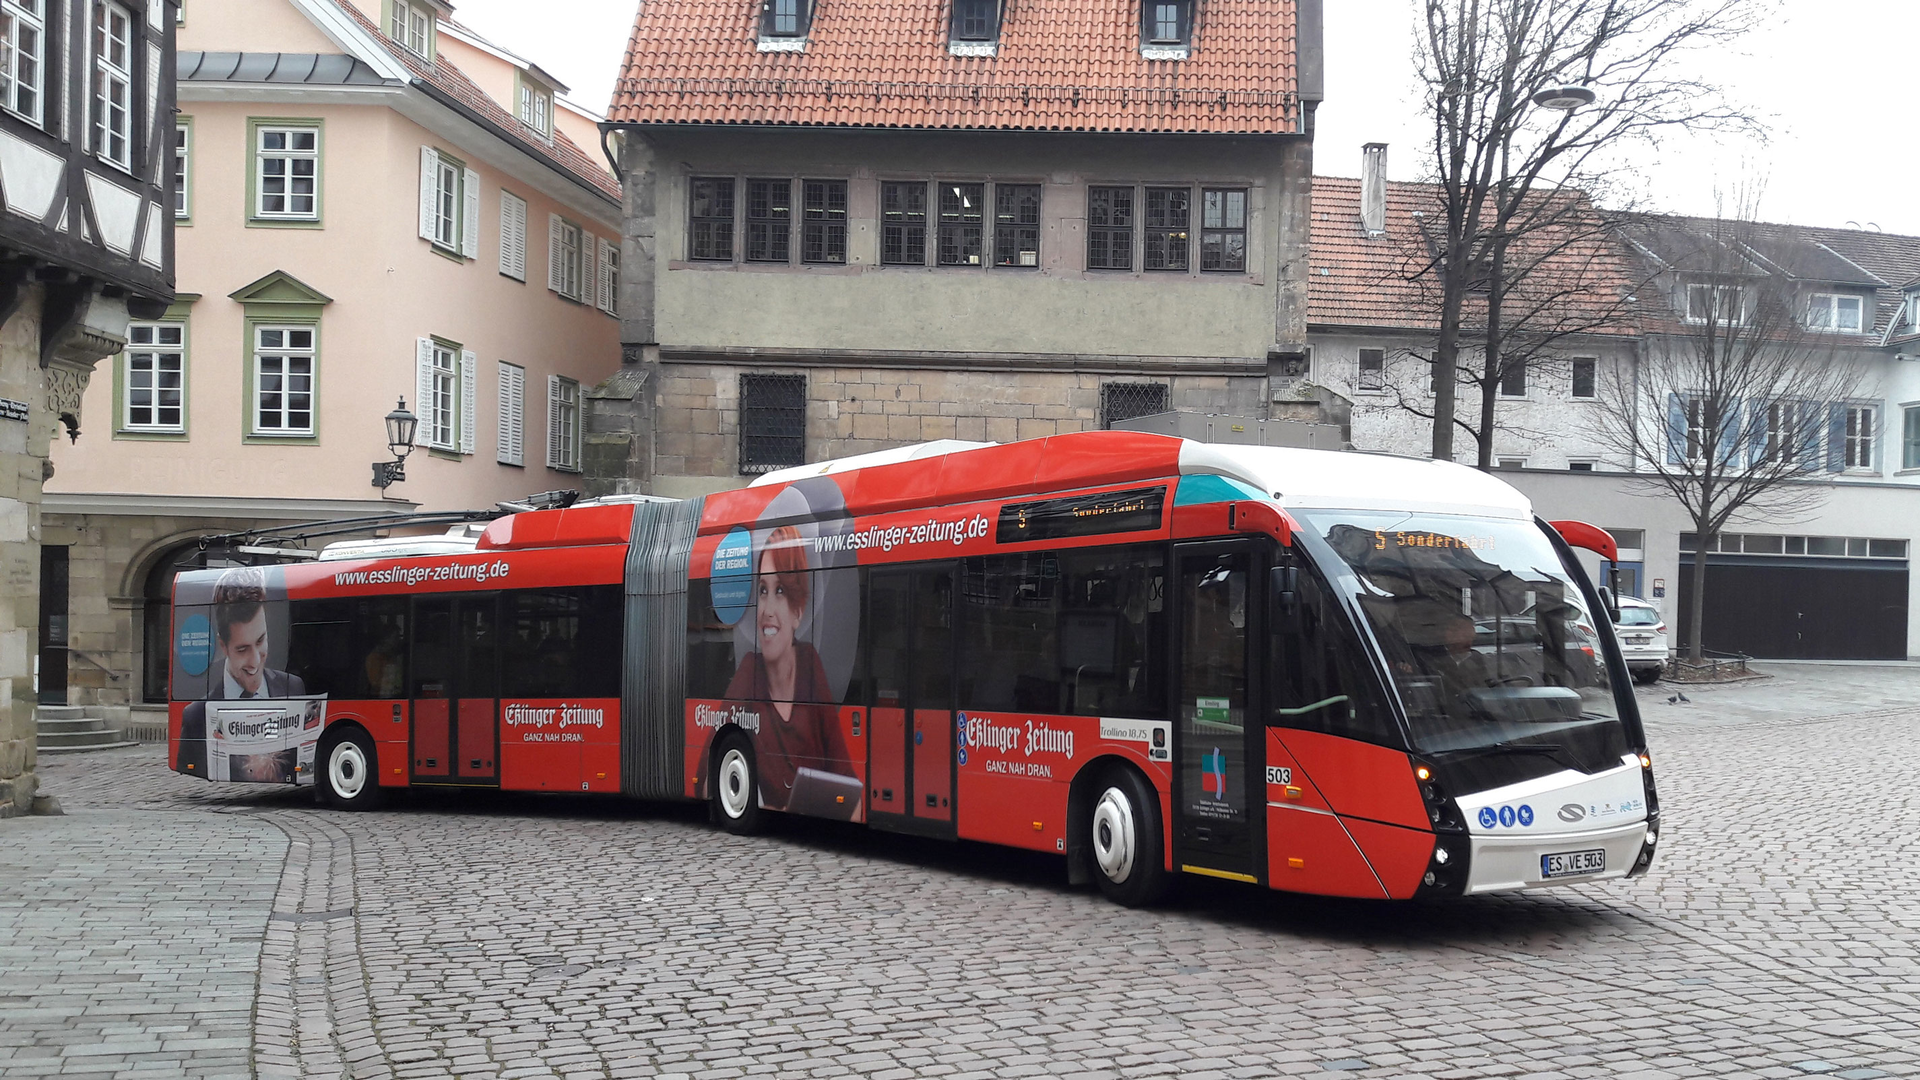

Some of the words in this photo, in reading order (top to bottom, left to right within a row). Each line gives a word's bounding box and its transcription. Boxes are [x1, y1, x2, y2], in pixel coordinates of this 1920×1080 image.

[814, 513, 988, 552] www.esslinger-zeitung.de
[334, 560, 509, 586] www.esslinger-zeitung.de
[505, 703, 556, 728] Eßlinger
[559, 703, 604, 729] Zeitung
[694, 704, 728, 733] Eßlinger
[228, 720, 266, 738] Eßlinger
[523, 732, 543, 742] GANZ
[544, 732, 560, 742] NAH
[561, 732, 585, 742] DRAN.
[966, 717, 1021, 754] Eßlinger
[1024, 719, 1074, 760] Zeitung
[1101, 727, 1128, 738] Trollino
[1128, 728, 1148, 740] 18,75
[986, 759, 1008, 774] GANZ
[1008, 761, 1026, 776] NAH
[1027, 763, 1053, 778] DRAN.
[1267, 768, 1291, 784] 503
[1548, 856, 1563, 872] ES
[1569, 854, 1582, 870] VE
[1584, 852, 1603, 868] 503
